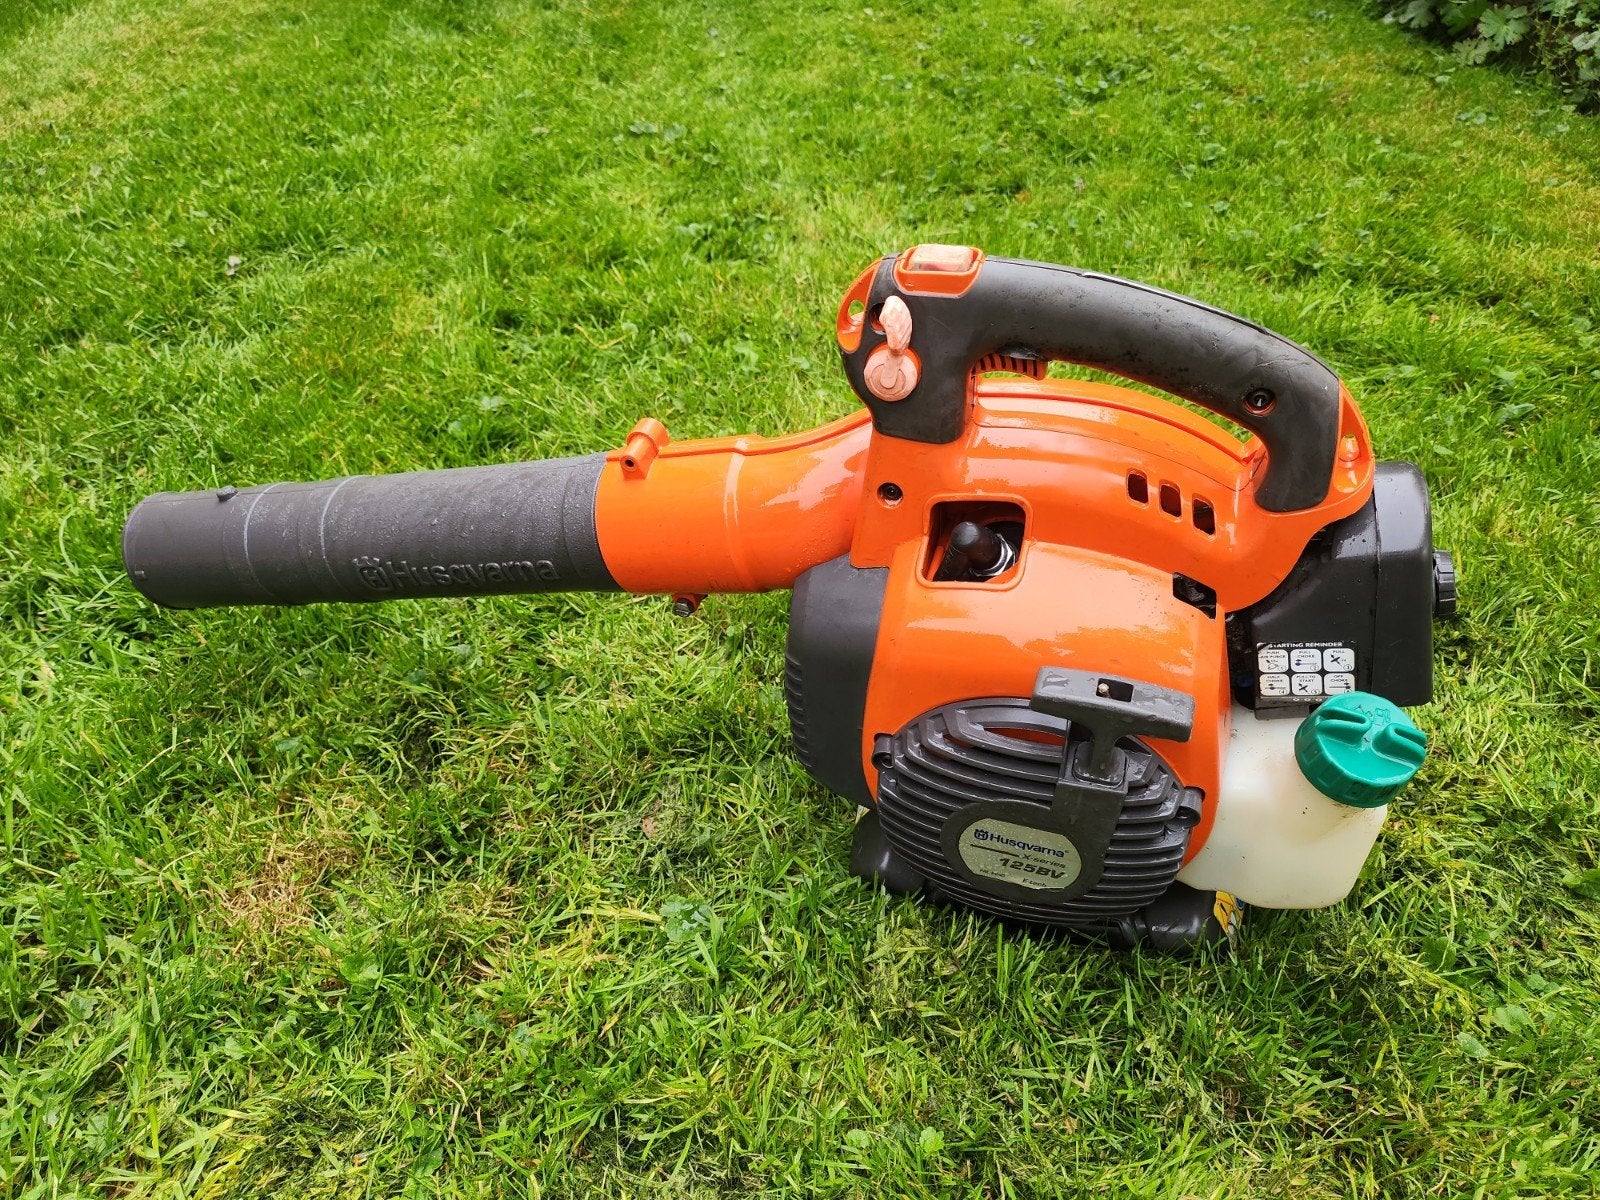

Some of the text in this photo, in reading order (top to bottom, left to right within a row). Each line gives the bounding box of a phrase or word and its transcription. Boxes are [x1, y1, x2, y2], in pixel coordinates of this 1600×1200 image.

[387, 559, 560, 587] Husqvarna
[989, 833, 1065, 858] Husqvarna
[999, 858, 1066, 879] 125BV
[1023, 853, 1066, 869] X-series
